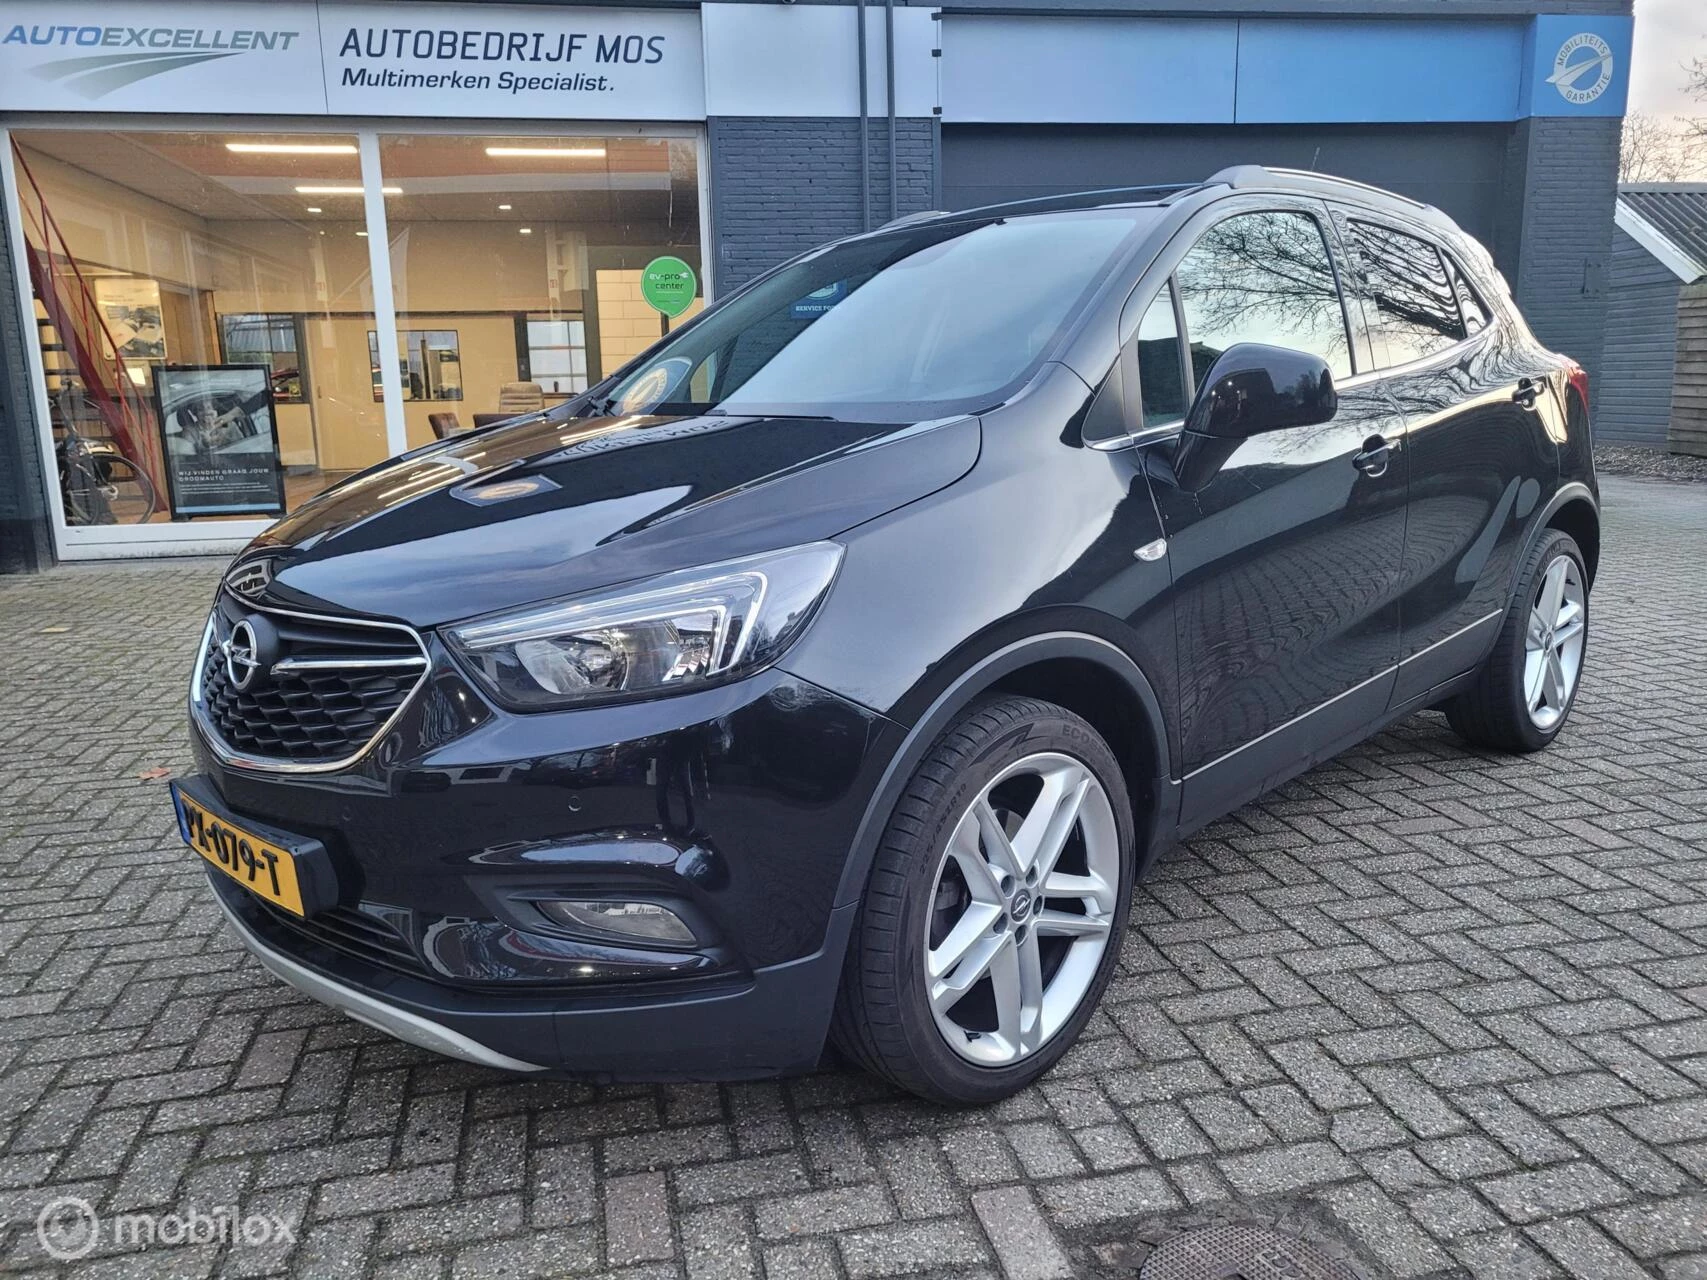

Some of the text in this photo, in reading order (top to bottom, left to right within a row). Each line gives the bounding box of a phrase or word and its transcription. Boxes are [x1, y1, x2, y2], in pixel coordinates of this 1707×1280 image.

[2, 25, 300, 50] AUTOEXCELLENT
[339, 28, 666, 64] AUTOBEDRIJF MOS
[1556, 34, 1609, 66] MOBILITEITS
[341, 67, 615, 94] Multimerken Specialist.
[1566, 72, 1611, 102] GARANTIE
[655, 282, 684, 290] center
